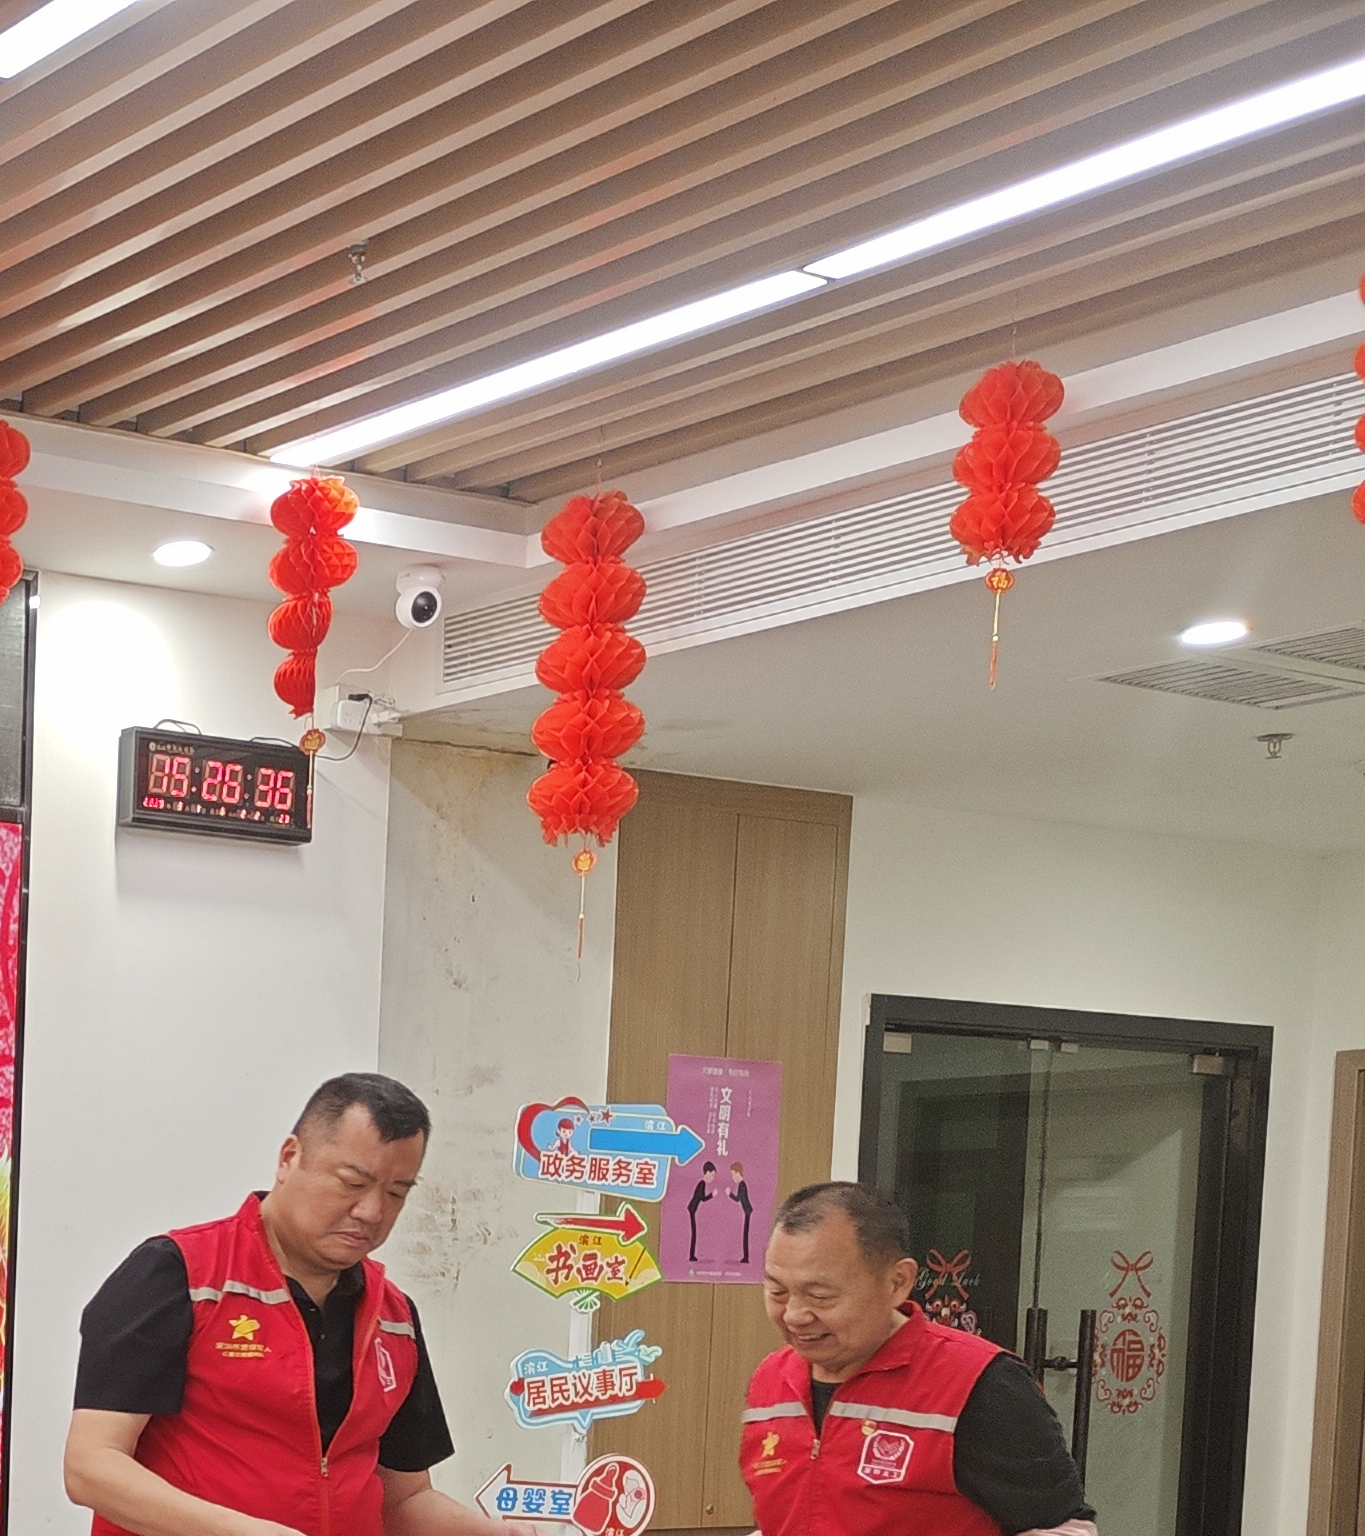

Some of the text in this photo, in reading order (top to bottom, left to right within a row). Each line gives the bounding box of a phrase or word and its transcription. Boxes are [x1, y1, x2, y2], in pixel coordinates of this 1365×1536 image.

[716, 1086, 733, 1156] 文明有礼
[540, 1153, 657, 1186] 政务服务室
[545, 1242, 626, 1286] 书画室
[1109, 1328, 1145, 1383] 福
[525, 1364, 639, 1411] 居民议事厅
[495, 1486, 574, 1516] 母婴室
